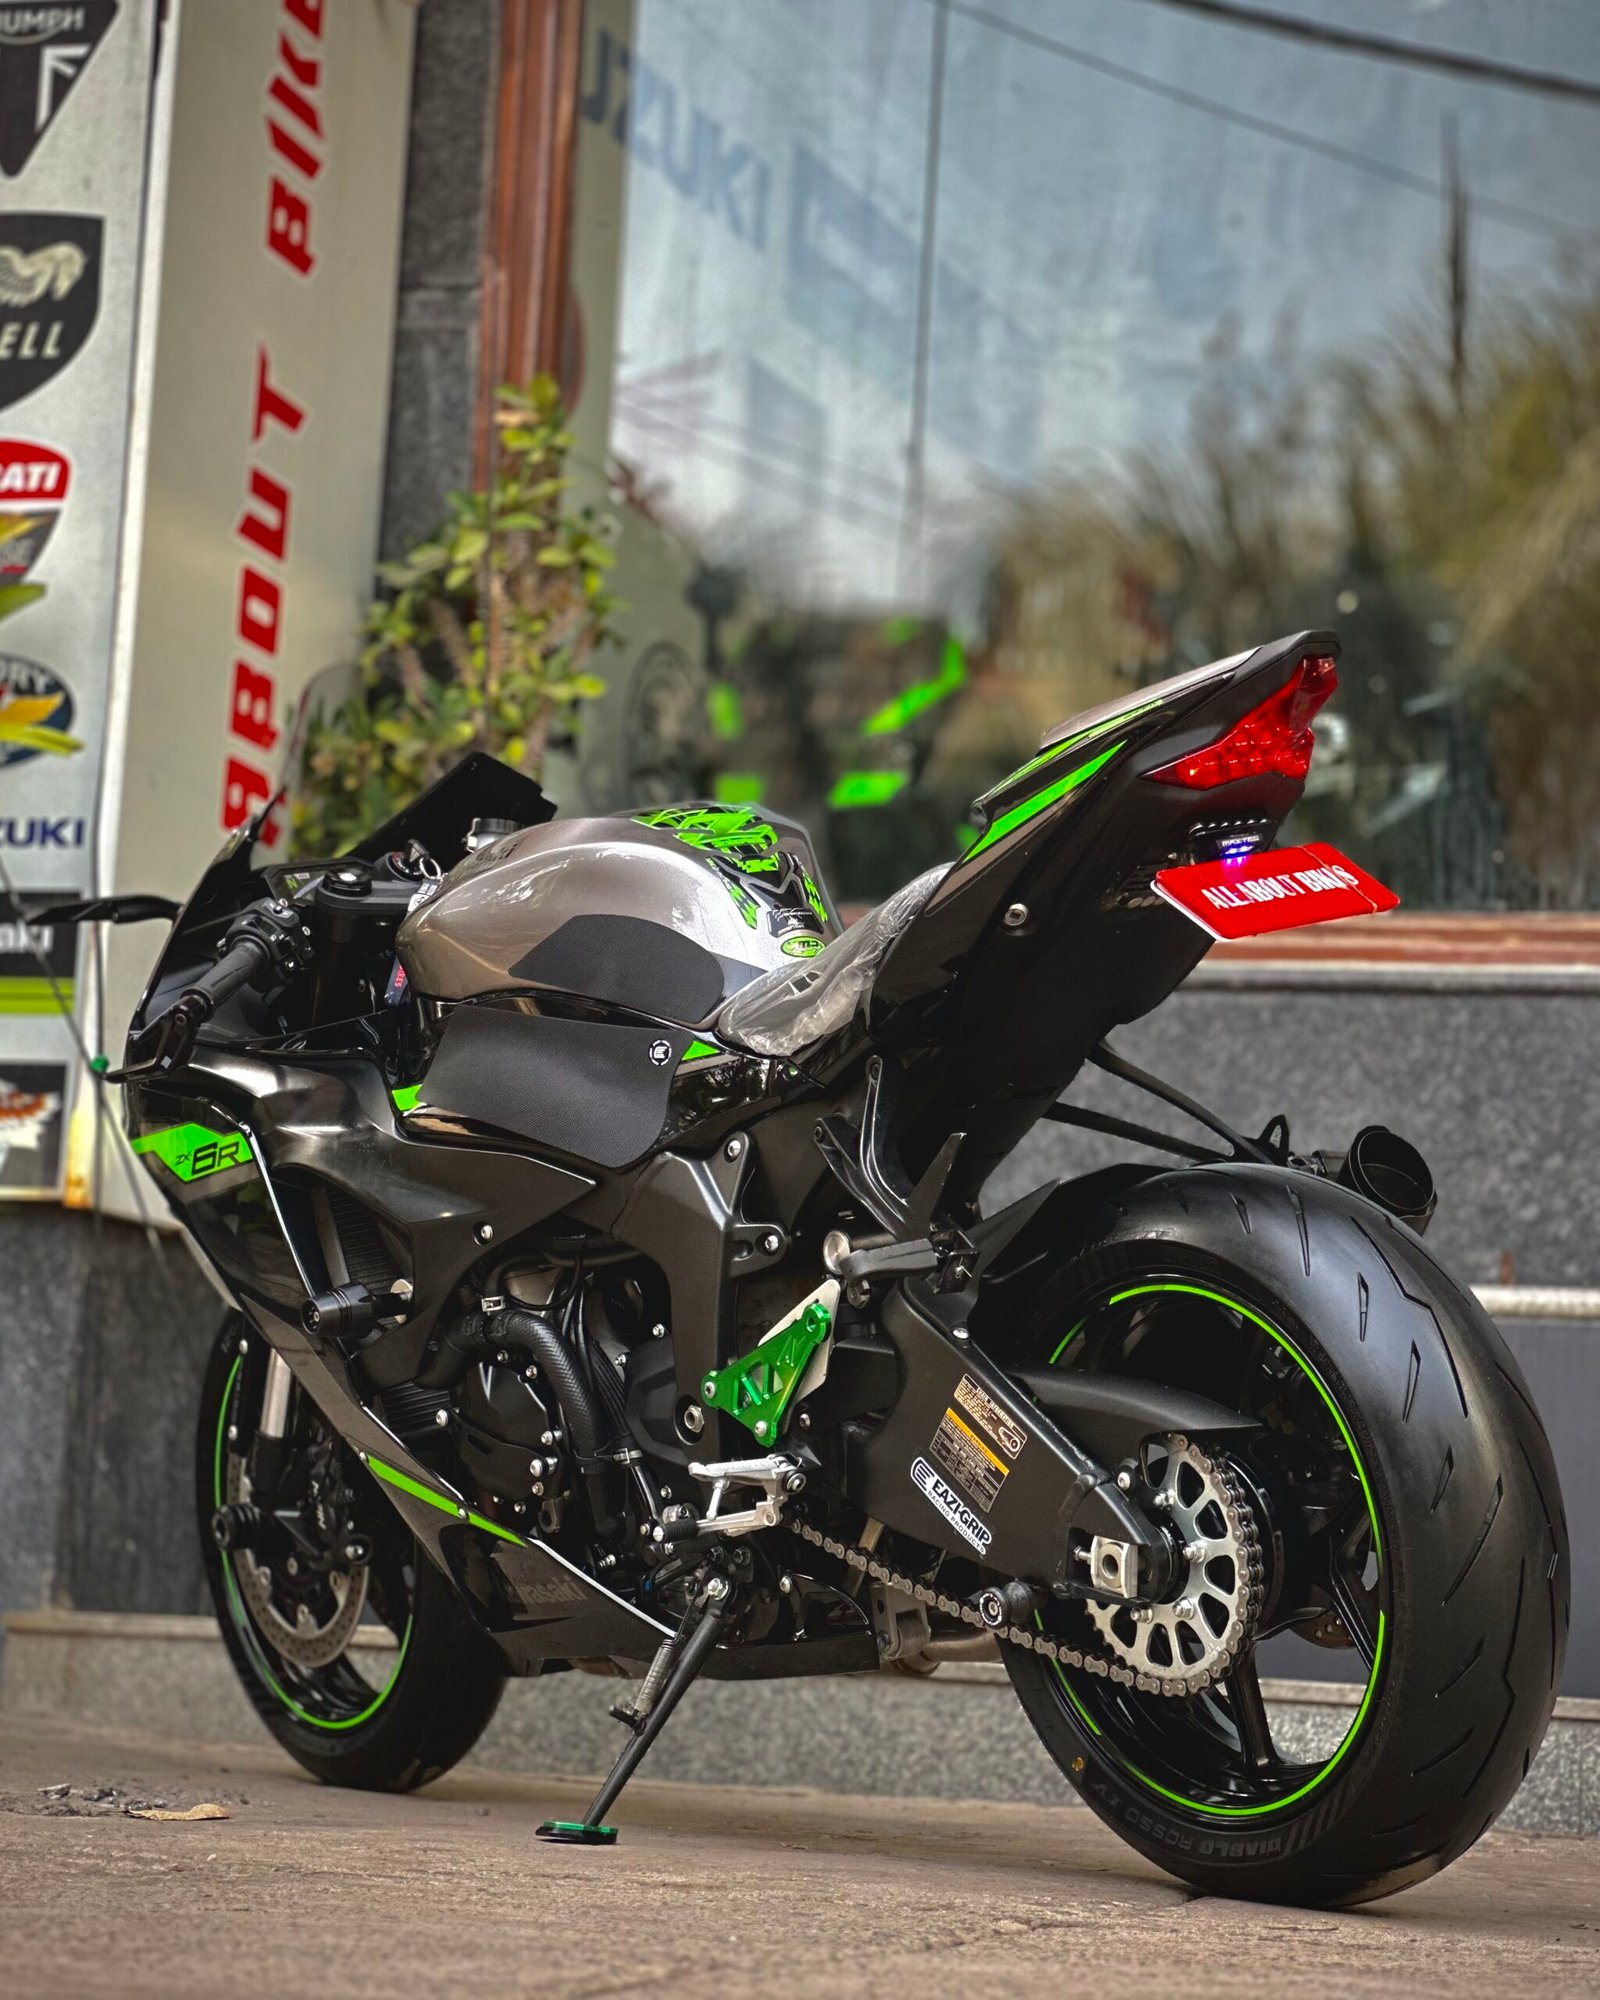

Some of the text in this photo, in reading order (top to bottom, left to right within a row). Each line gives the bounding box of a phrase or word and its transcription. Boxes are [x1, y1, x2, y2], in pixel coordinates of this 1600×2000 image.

[0, 461, 62, 492] ATI
[0, 817, 85, 848] UKI
[1201, 885, 1250, 910] ALL
[1235, 874, 1306, 903] ABOUT
[927, 1490, 950, 1518] RACING
[950, 1515, 985, 1553] PRODUCTS
[931, 1478, 990, 1543] EAZI-GRIP
[1125, 1807, 1194, 1850] ROSSO
[1201, 1837, 1282, 1857] DIABLO
